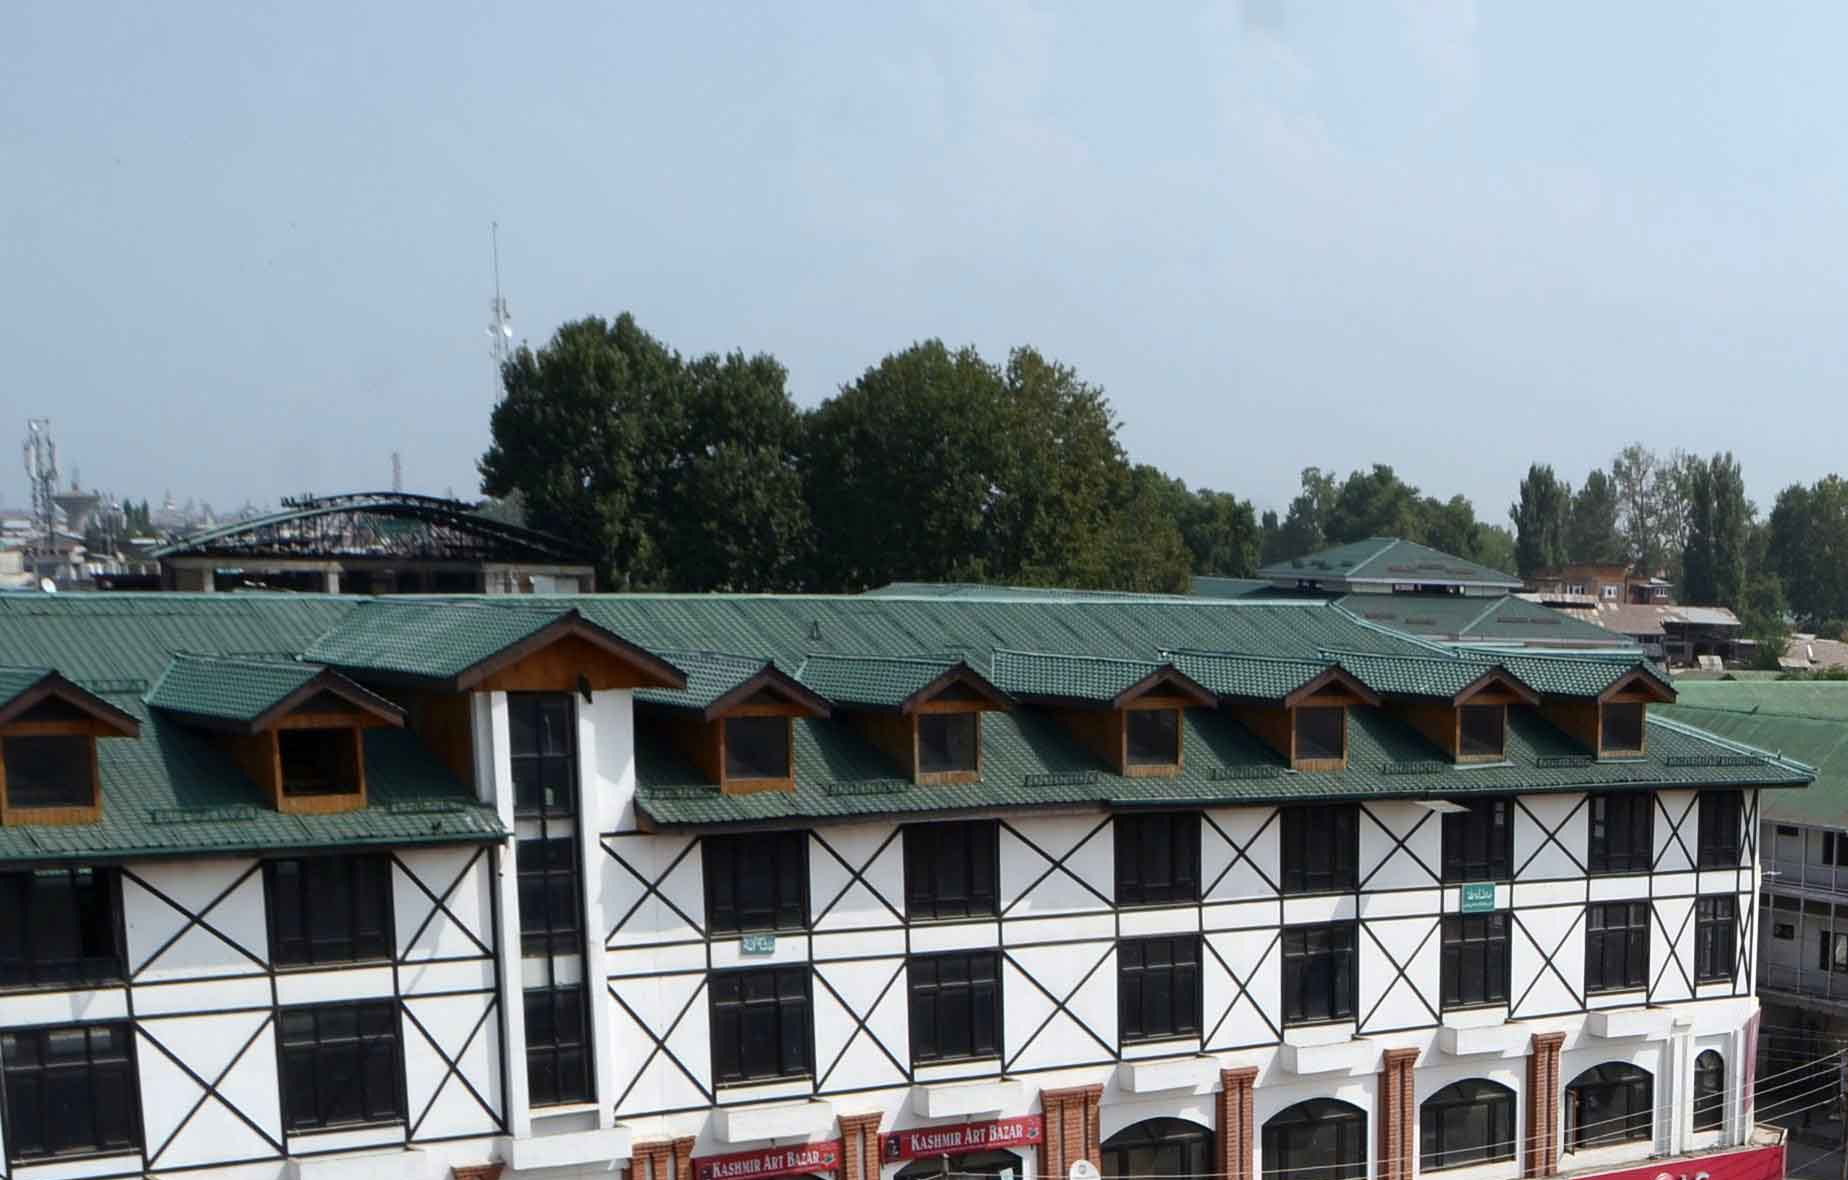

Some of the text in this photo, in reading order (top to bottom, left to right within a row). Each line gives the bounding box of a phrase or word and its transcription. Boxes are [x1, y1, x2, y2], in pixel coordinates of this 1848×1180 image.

[911, 1131, 961, 1152] KASHMIR
[989, 1123, 1023, 1142] BAZAR
[712, 1159, 761, 1178] KASHMIR
[787, 1150, 820, 1167] BAZAR
